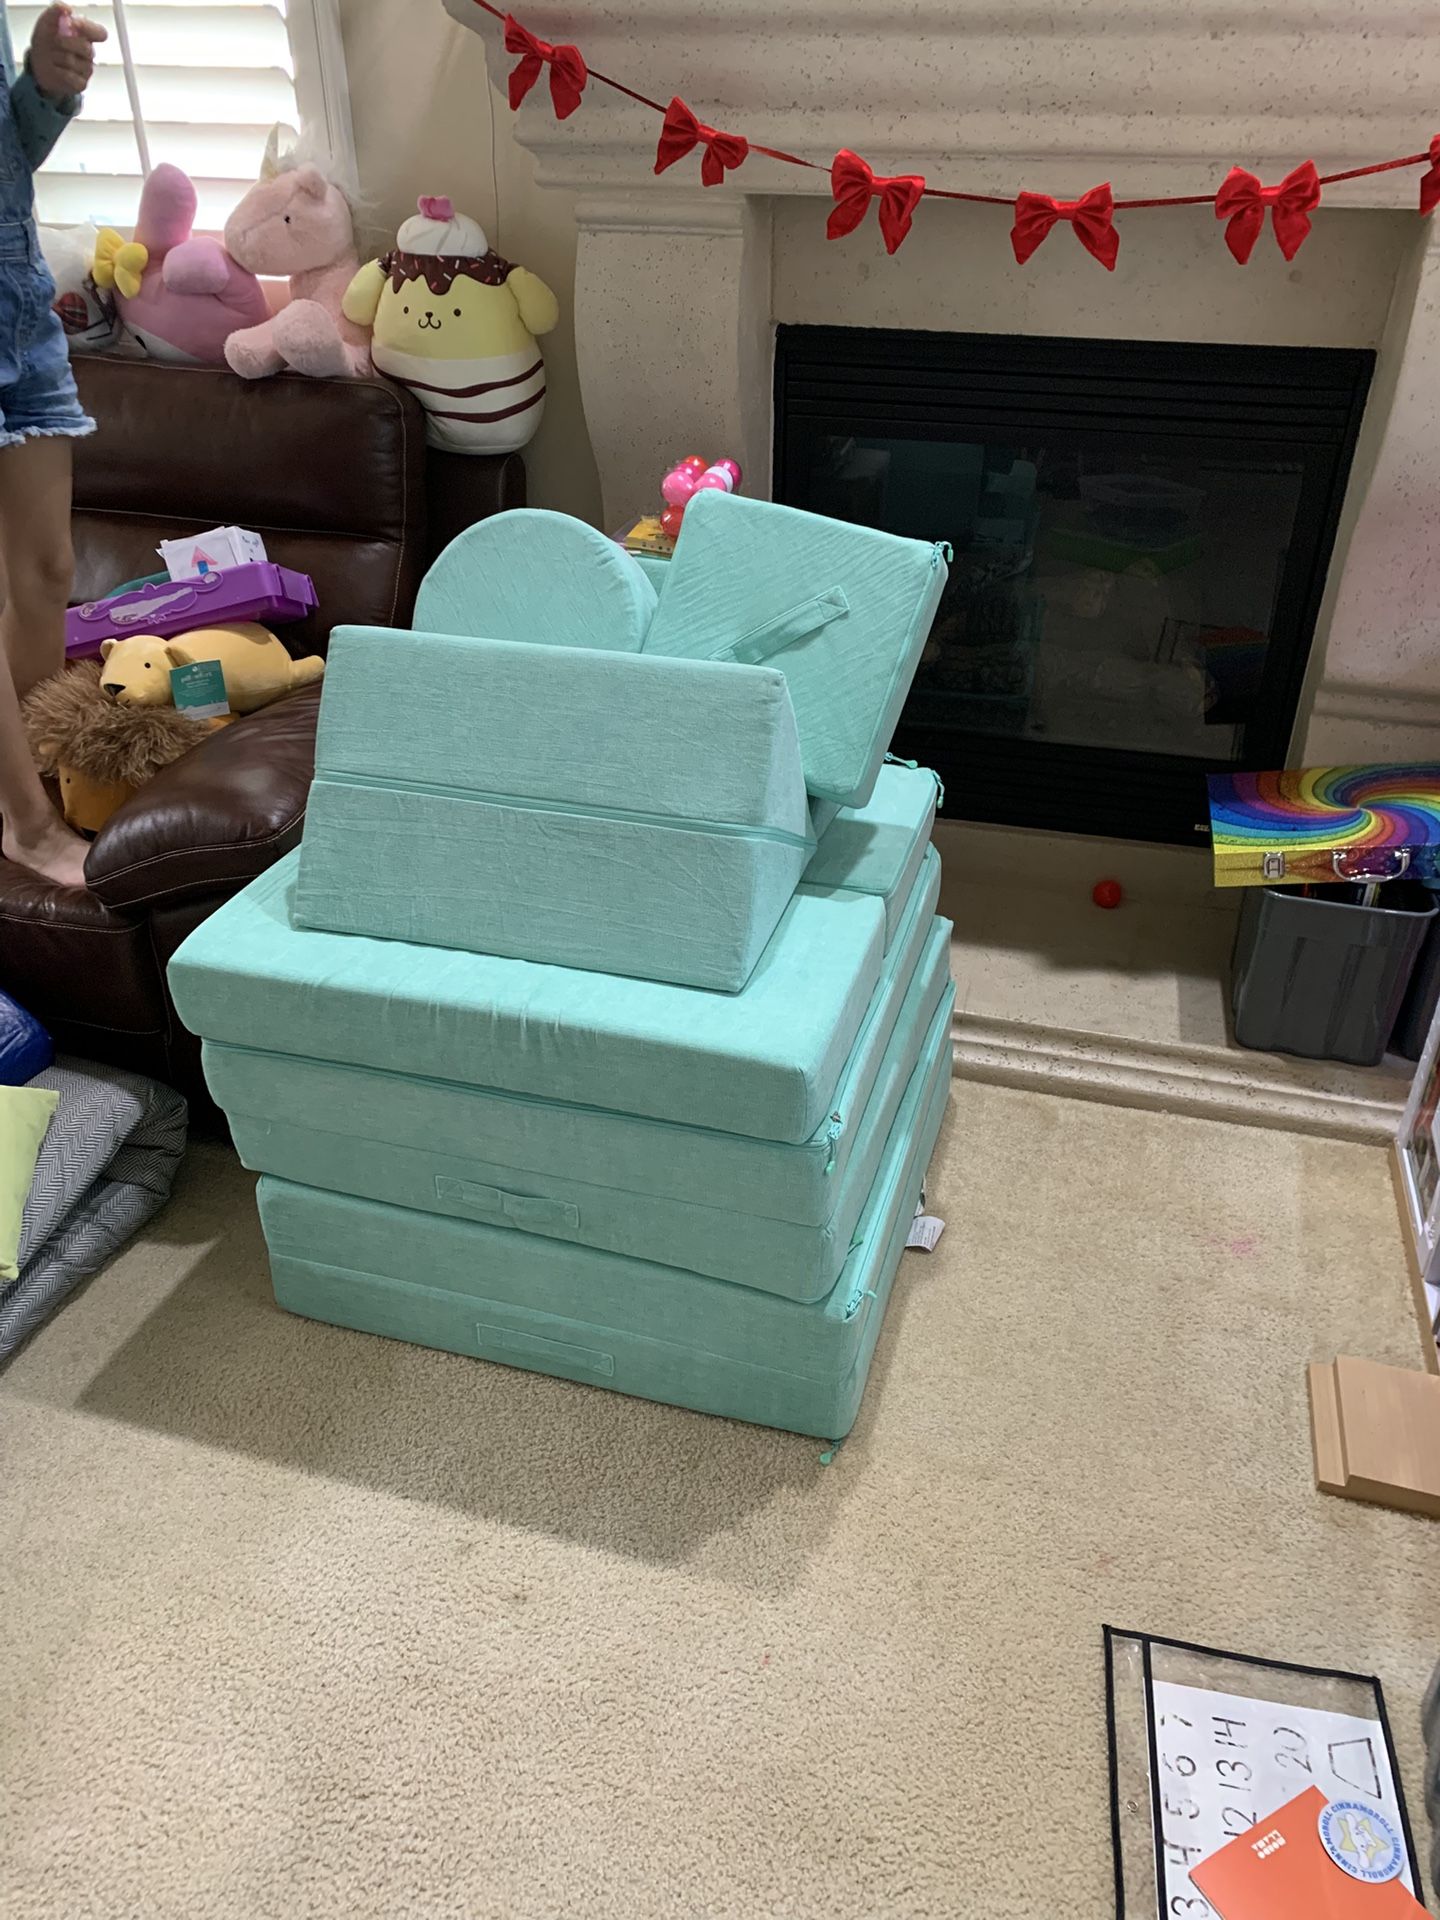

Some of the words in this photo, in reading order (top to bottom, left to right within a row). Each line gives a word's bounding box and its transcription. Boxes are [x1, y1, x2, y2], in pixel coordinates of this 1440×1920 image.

[1159, 1713, 1193, 1728] 7
[1211, 1716, 1248, 1749] 14
[1273, 1726, 1313, 1773] 20
[1162, 1753, 1197, 1777] 6
[1215, 1759, 1253, 1791] 13
[1164, 1793, 1200, 1819] 5
[1221, 1806, 1257, 1836] 12
[1163, 1835, 1202, 1866] 4
[1170, 1895, 1210, 1919] 3
